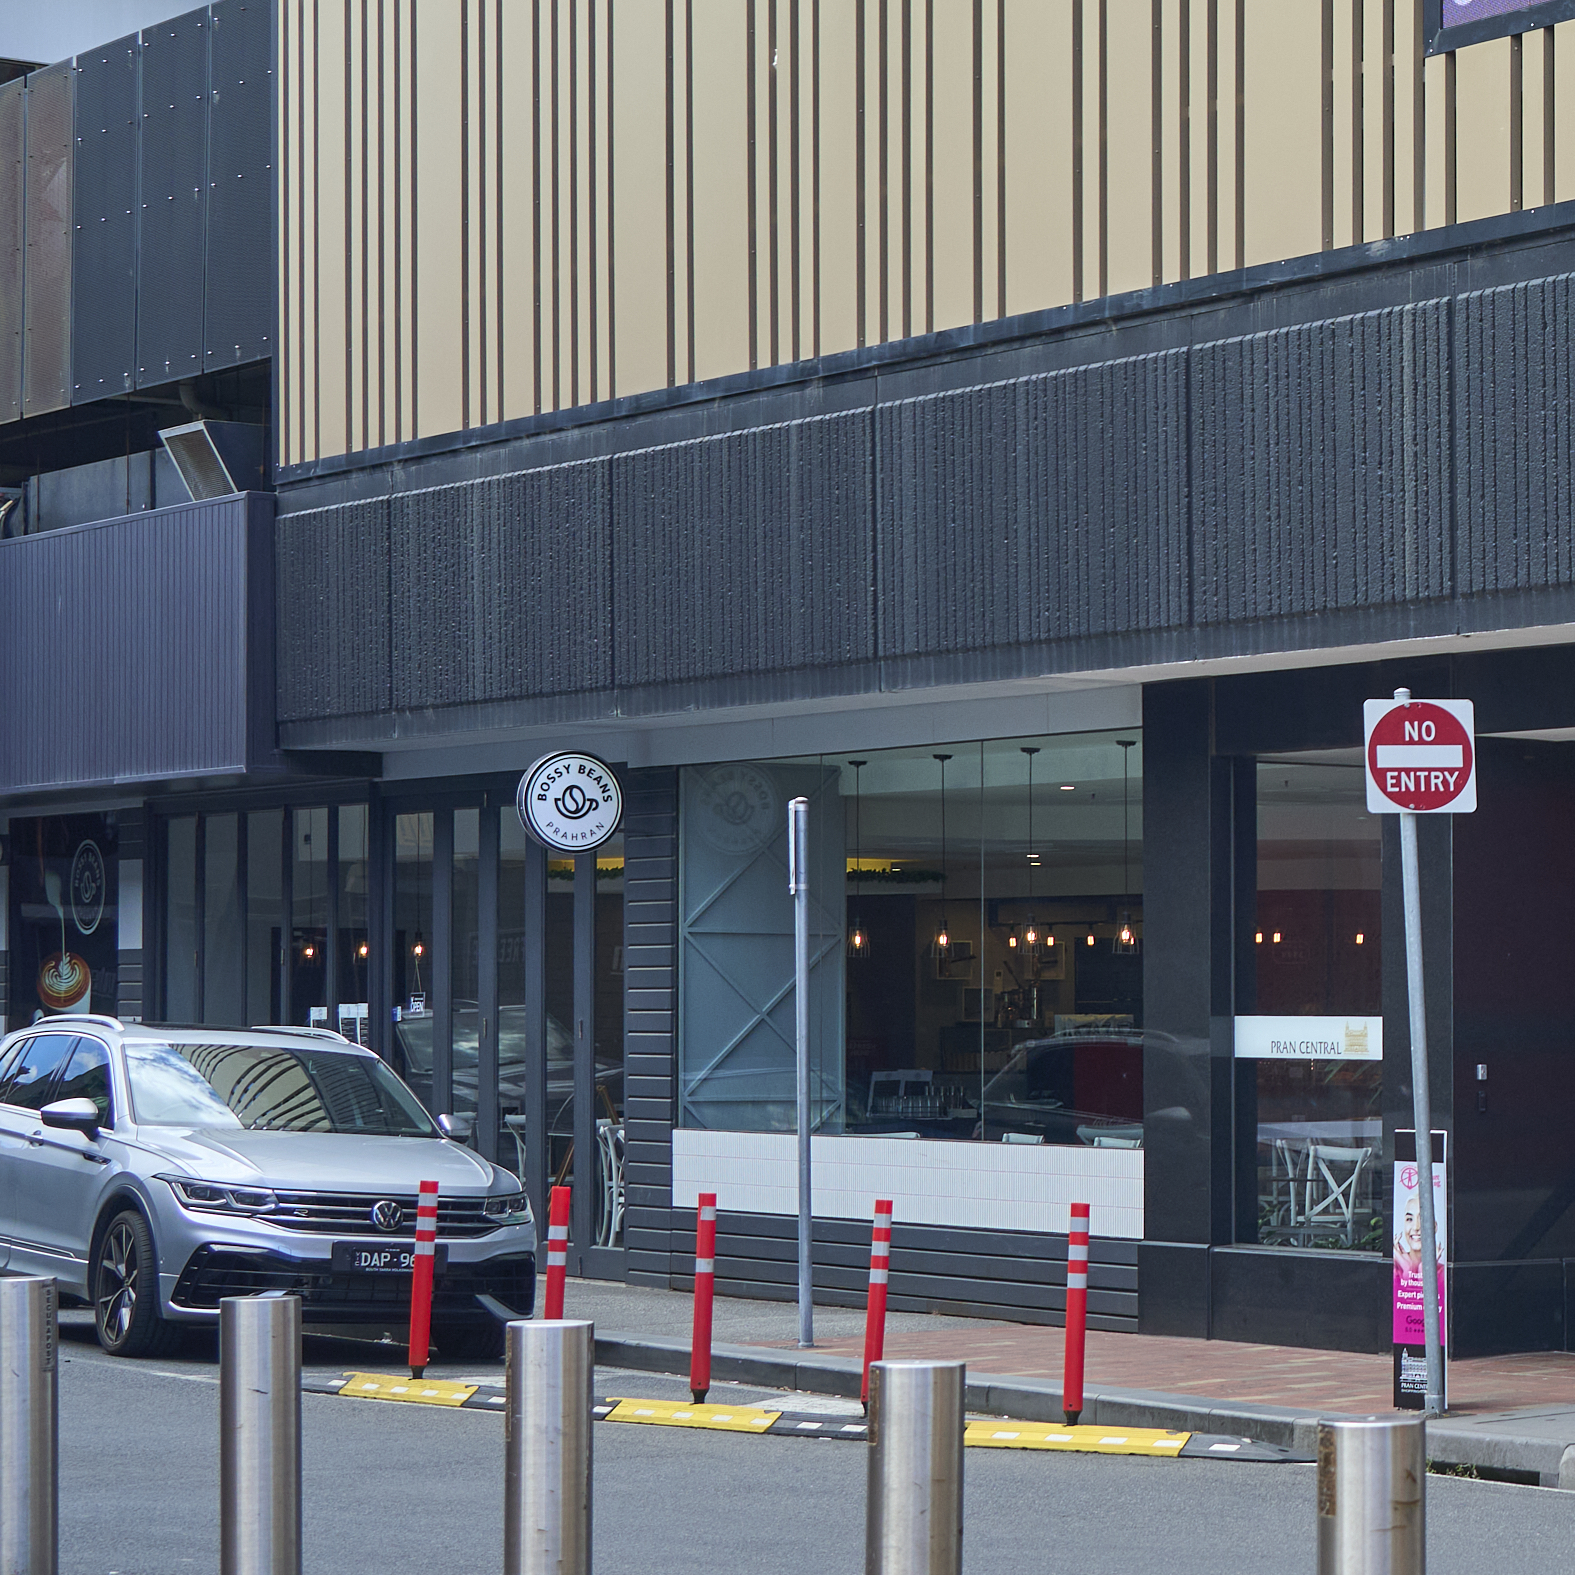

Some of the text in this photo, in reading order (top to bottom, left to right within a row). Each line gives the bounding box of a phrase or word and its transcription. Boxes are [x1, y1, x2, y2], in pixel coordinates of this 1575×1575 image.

[1404, 720, 1436, 741] NO
[537, 764, 613, 802] BOSSY BEANS
[1386, 771, 1459, 792] ENTRY
[546, 821, 605, 841] PRAHRAN
[411, 1001, 424, 1012] OPEN
[1270, 1040, 1342, 1055] PRAN CENTRAL
[1401, 1279, 1408, 1287] by
[1397, 1290, 1416, 1299] Expert
[1397, 1302, 1422, 1310] Premium
[1401, 1382, 1414, 1390] PRAN
